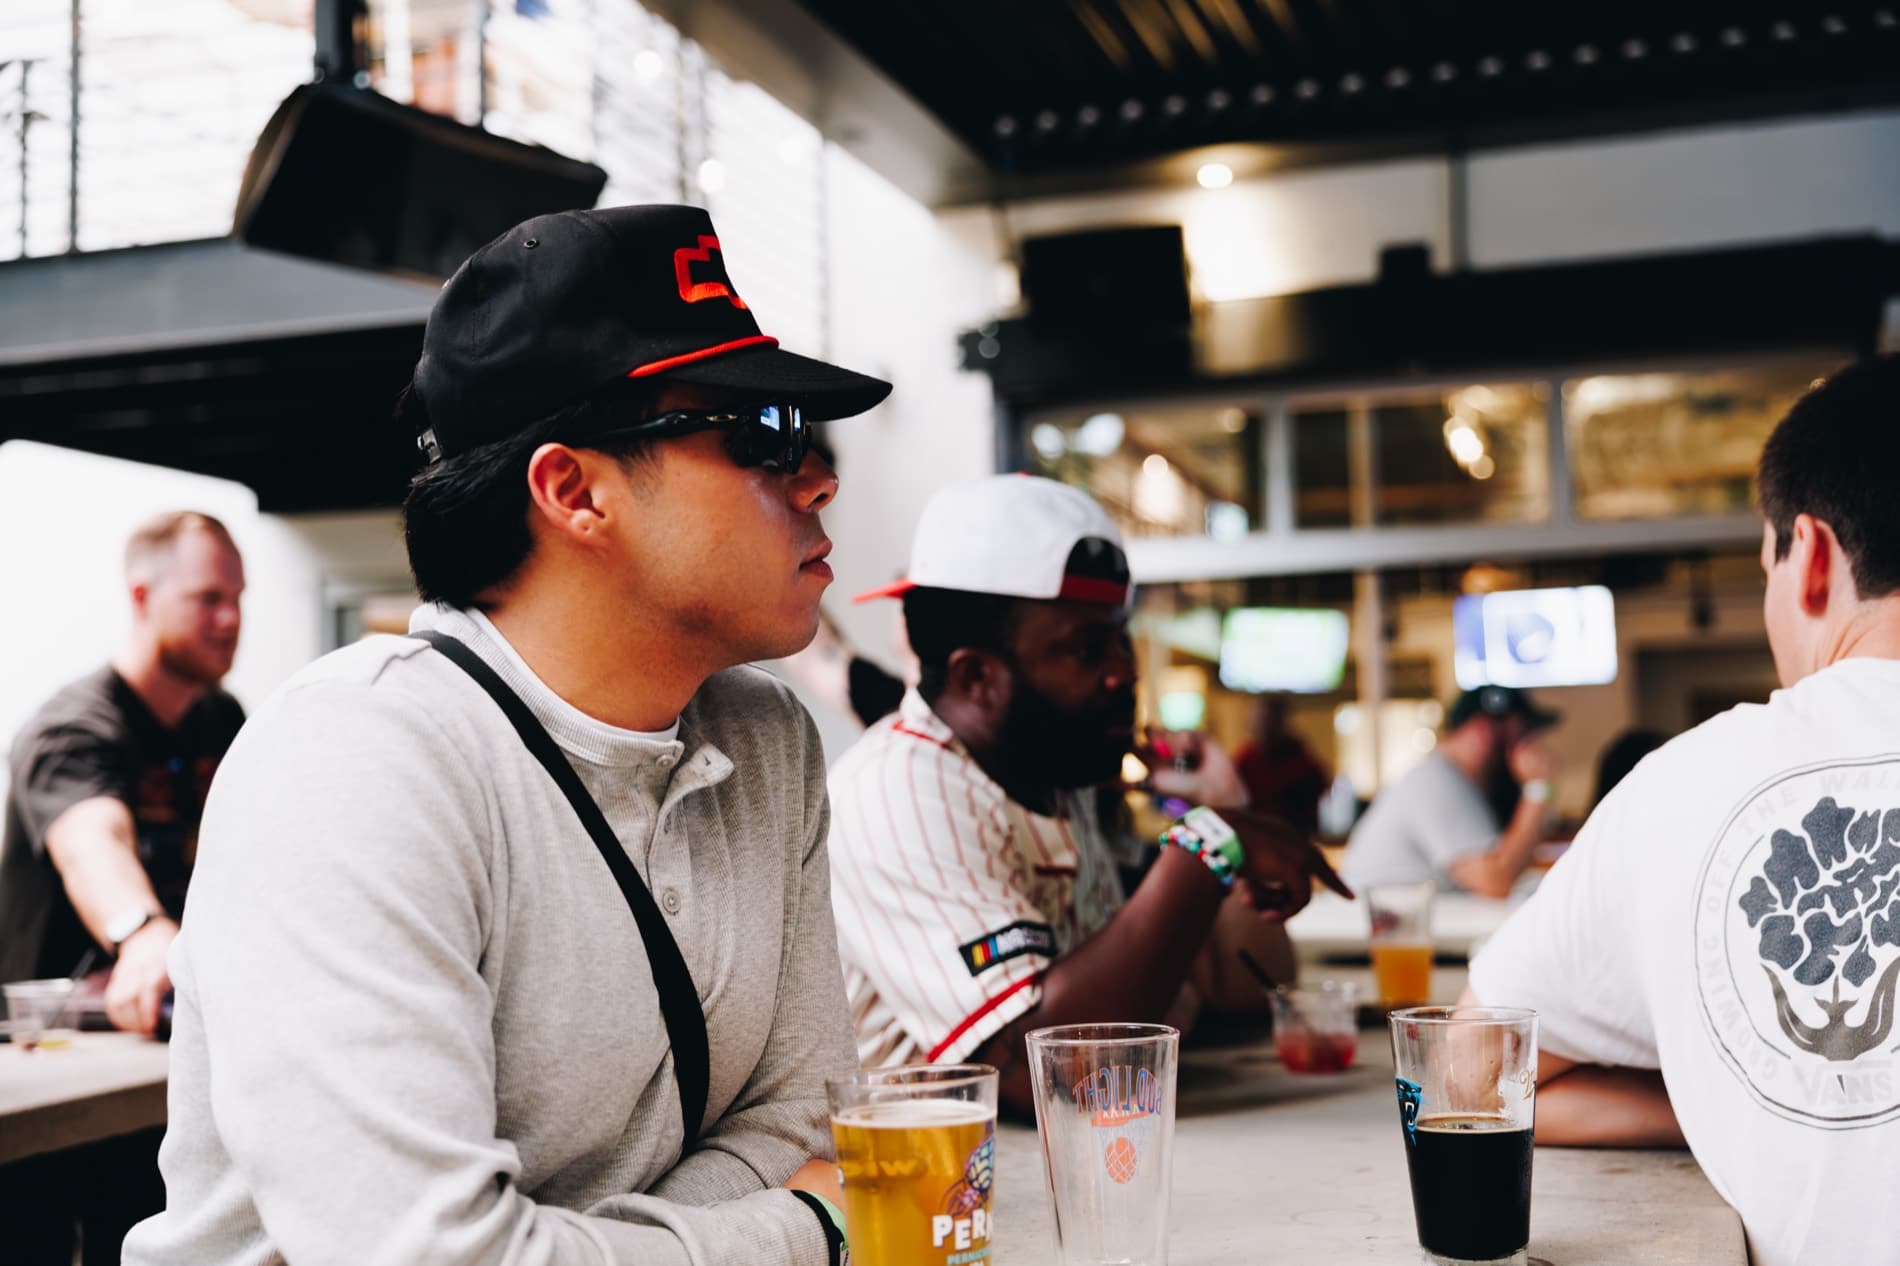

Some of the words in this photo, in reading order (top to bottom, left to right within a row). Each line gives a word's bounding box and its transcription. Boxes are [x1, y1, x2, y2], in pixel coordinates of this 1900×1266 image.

[1706, 849, 1733, 913] OFF
[1738, 785, 1800, 837] THE
[1792, 1059, 1894, 1106] VANS
